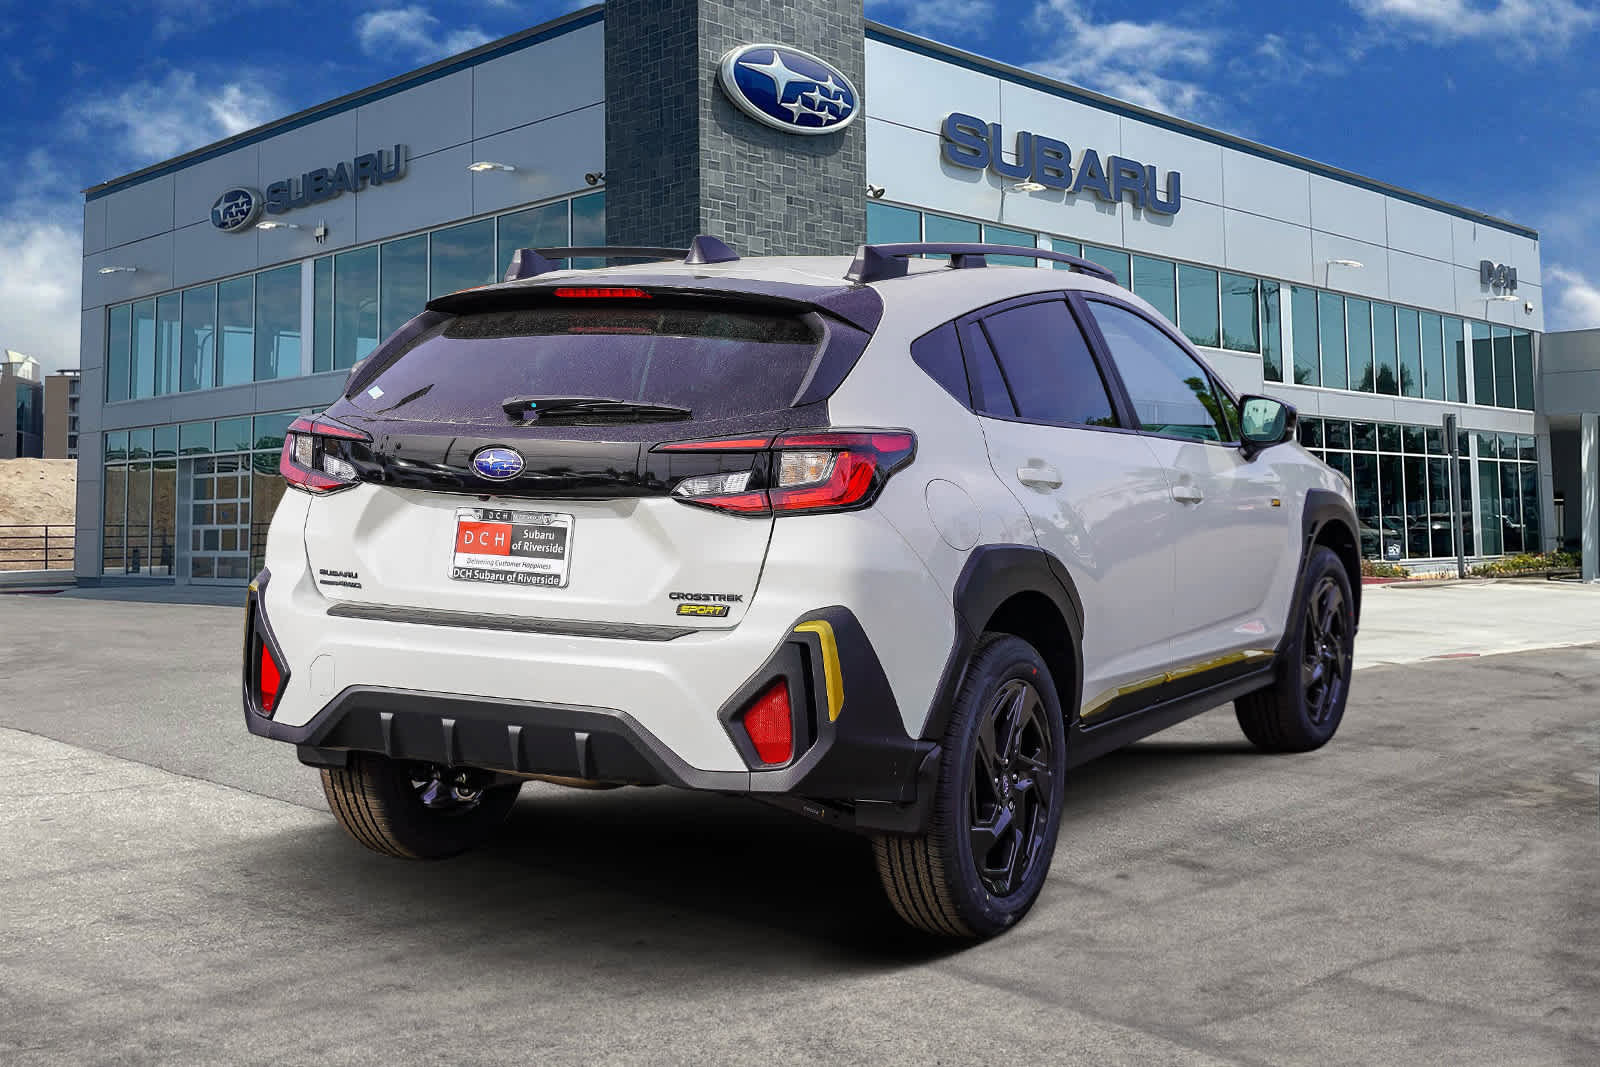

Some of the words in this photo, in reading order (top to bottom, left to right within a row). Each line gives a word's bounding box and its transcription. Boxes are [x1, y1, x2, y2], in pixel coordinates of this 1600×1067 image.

[943, 112, 1181, 215] SUBARU
[266, 144, 404, 214] SUBARU
[523, 529, 555, 540] Subaru
[511, 541, 522, 551] of
[523, 541, 564, 553] Riverside
[319, 568, 358, 578] SUBARU
[453, 568, 473, 579] DCH
[474, 570, 505, 581] Subaru
[506, 572, 517, 582] of
[517, 573, 560, 586] Riverside
[668, 591, 744, 602] CROSSTREK
[679, 604, 724, 615] SPORT
